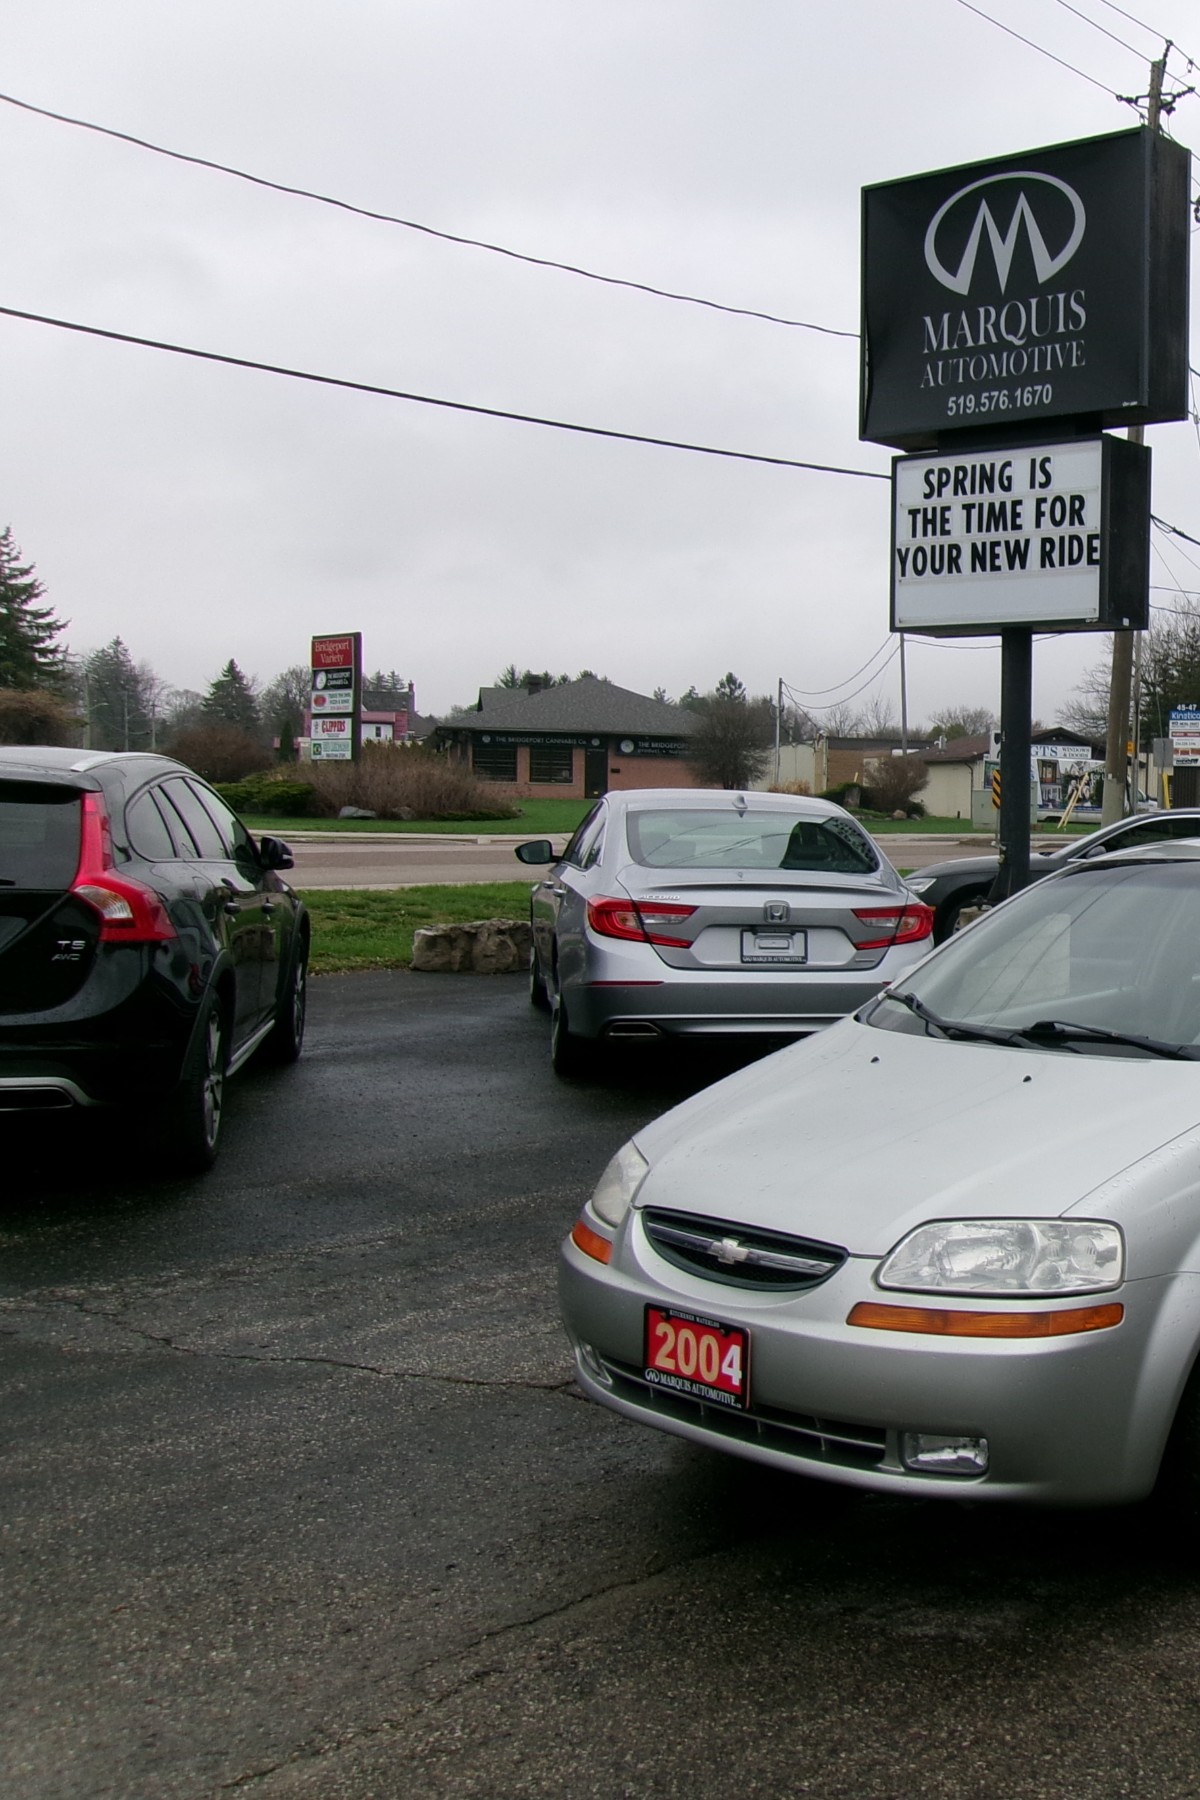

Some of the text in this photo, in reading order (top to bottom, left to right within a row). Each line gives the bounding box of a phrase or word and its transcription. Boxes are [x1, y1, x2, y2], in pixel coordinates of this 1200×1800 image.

[922, 289, 1087, 353] MARQUIS
[920, 340, 1086, 388] AUTOMOTIVE
[947, 383, 1052, 416] 519.576.1670
[923, 457, 1052, 500] SPRING IS
[908, 494, 1086, 539] THE TIME FOR
[896, 533, 1100, 577] YOUR NEW RIDE
[314, 640, 350, 653] Bridgeport
[320, 653, 344, 665] Variety
[1176, 703, 1198, 711] 45-47
[655, 1321, 742, 1387] 2004
[660, 1372, 692, 1393] MARQUIS
